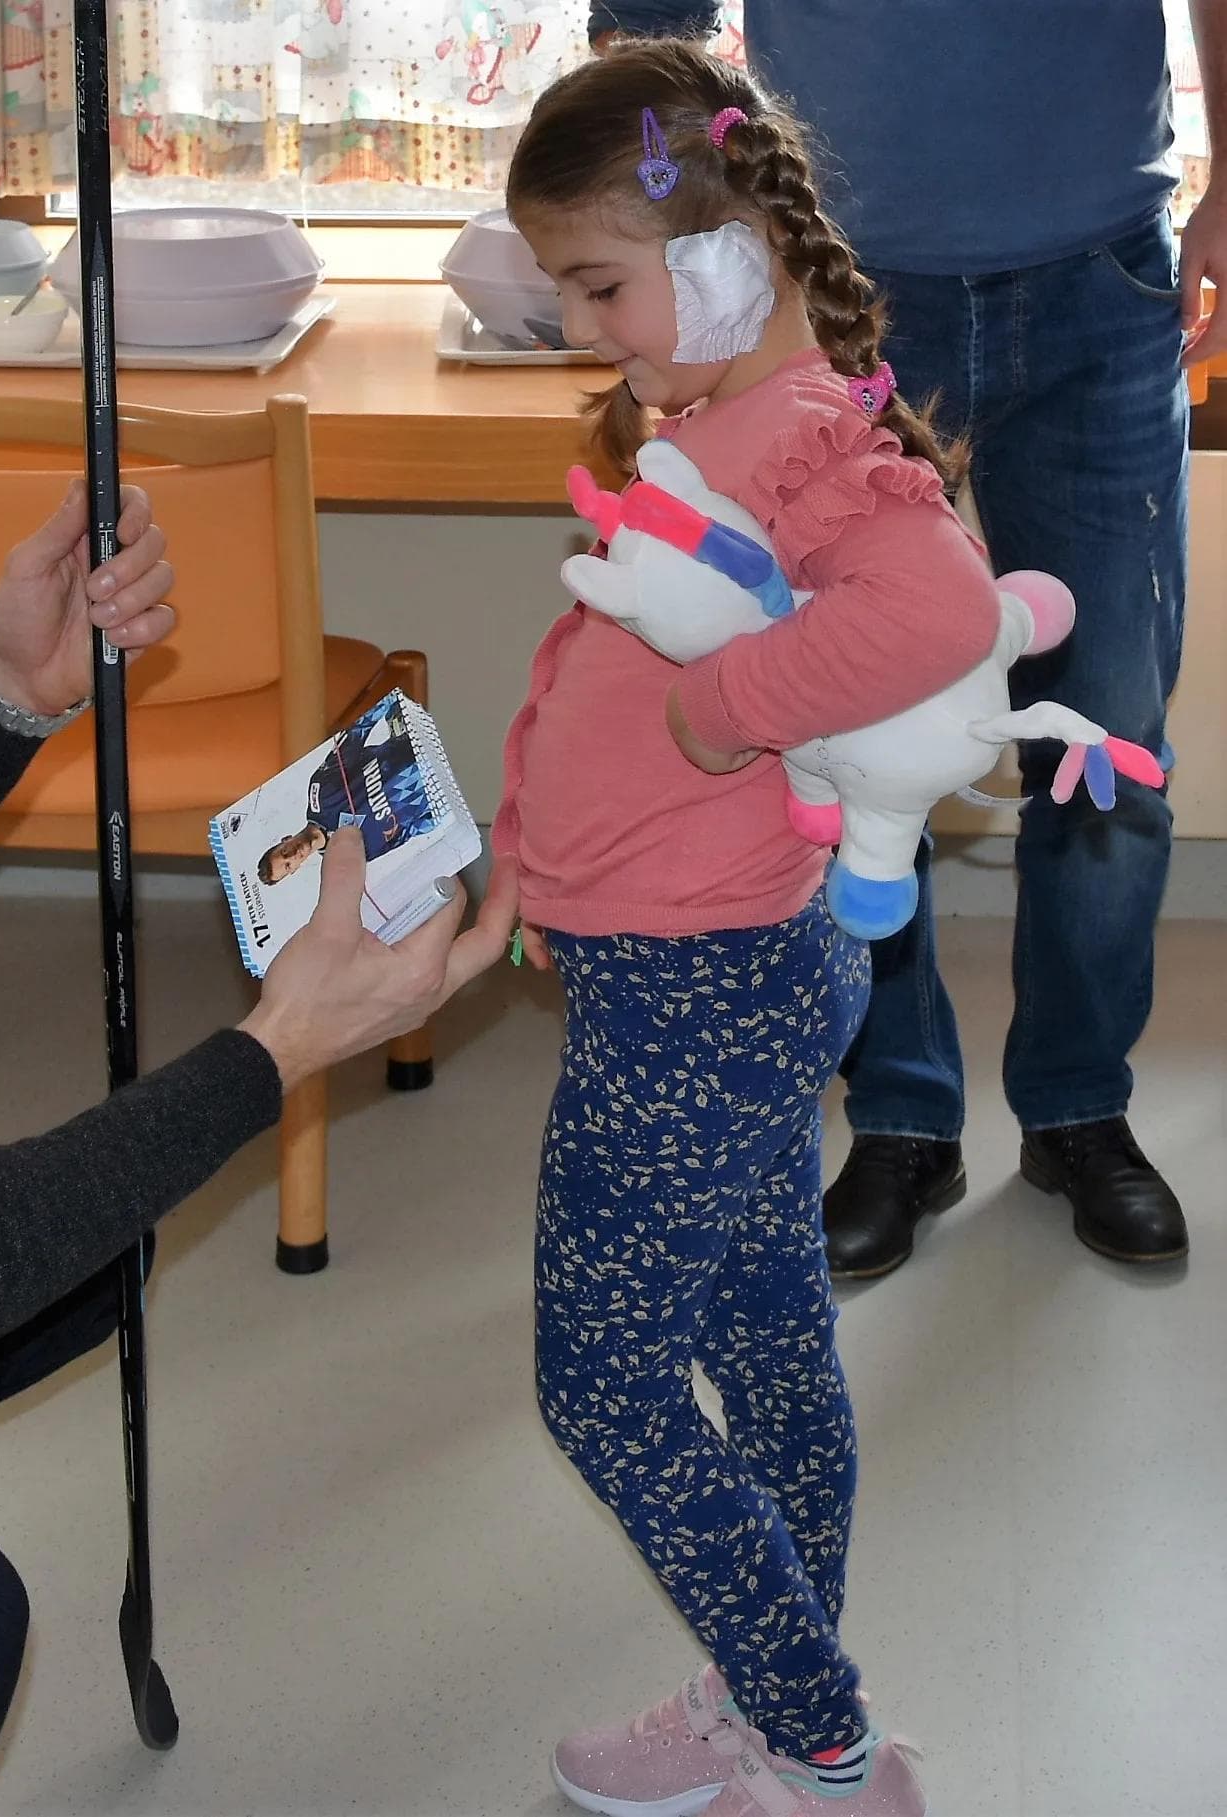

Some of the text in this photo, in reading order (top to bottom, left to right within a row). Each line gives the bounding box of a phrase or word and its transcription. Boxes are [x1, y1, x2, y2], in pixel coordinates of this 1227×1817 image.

[363, 758, 391, 821] SATURN
[112, 824, 122, 881] EASTON
[253, 925, 271, 948] 17
